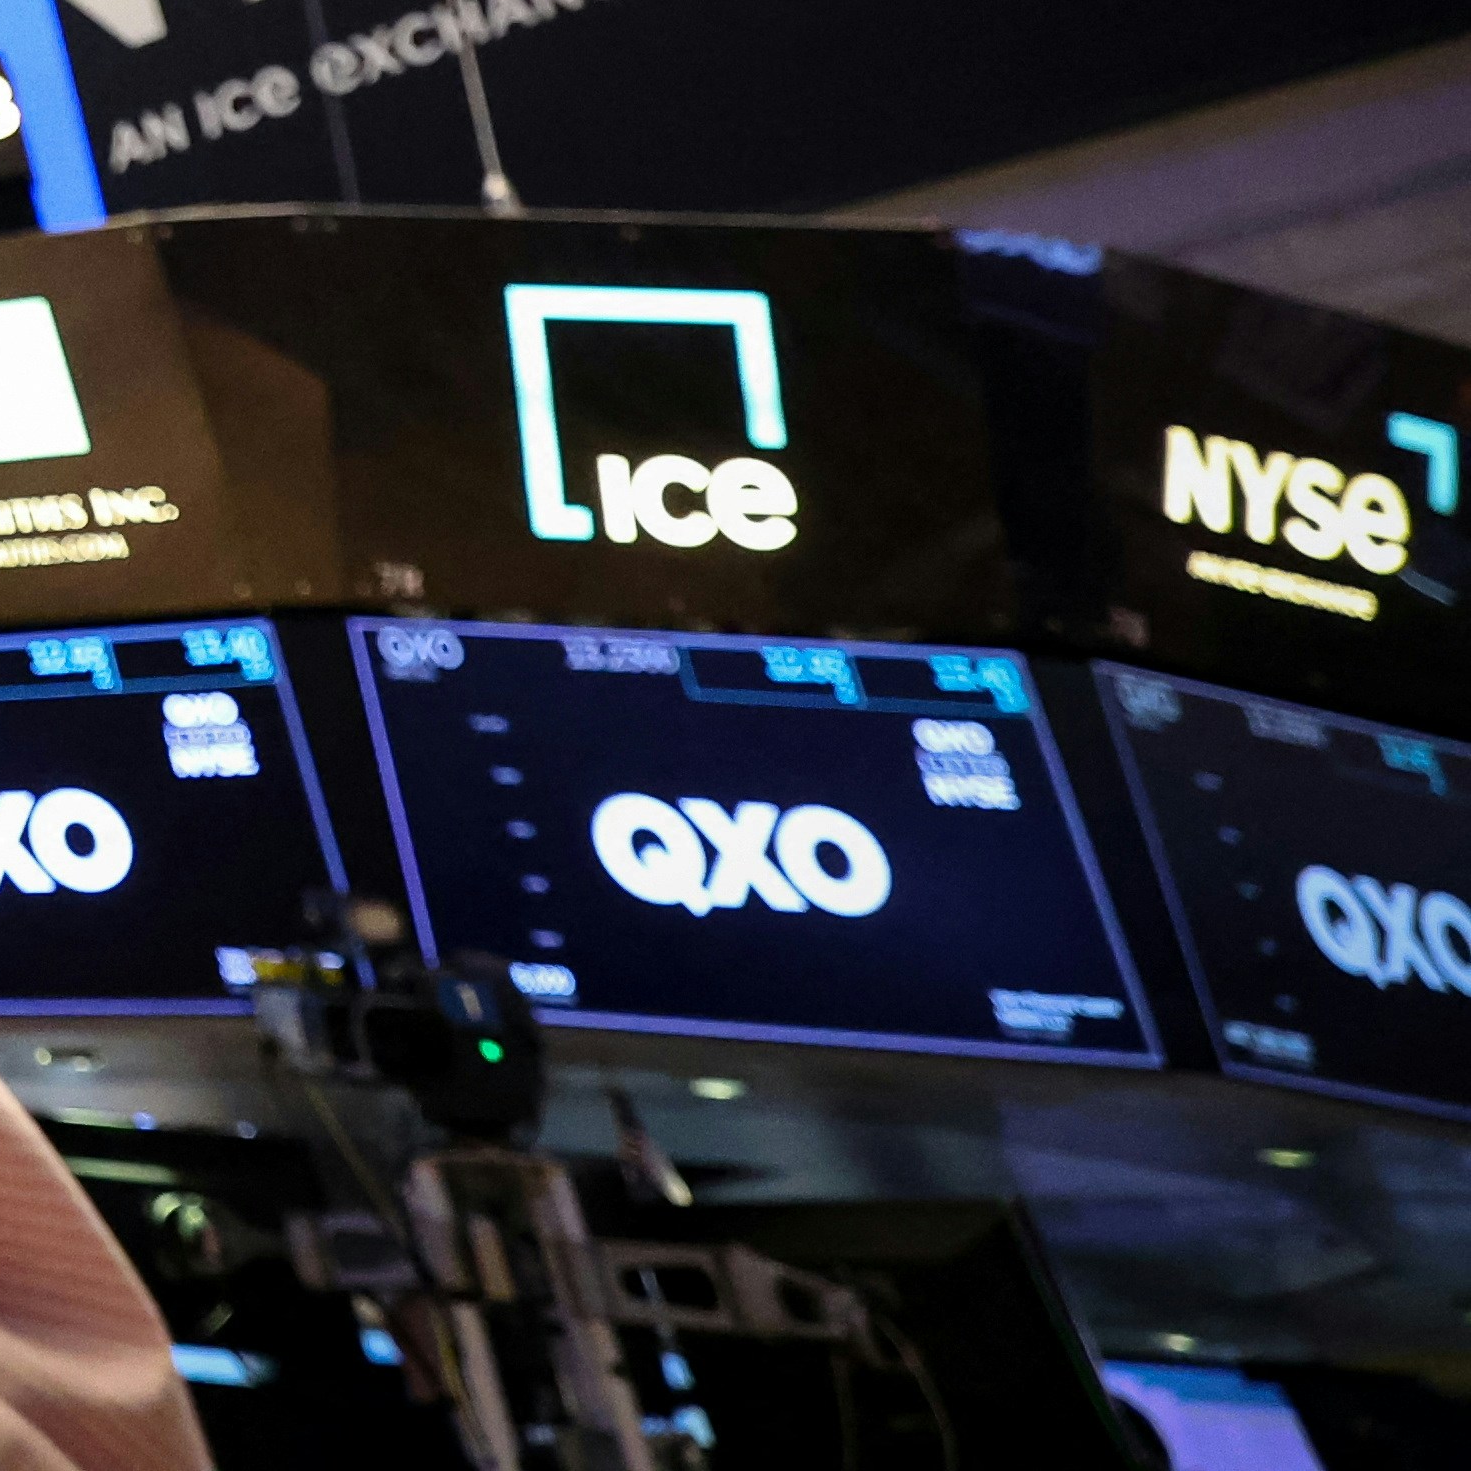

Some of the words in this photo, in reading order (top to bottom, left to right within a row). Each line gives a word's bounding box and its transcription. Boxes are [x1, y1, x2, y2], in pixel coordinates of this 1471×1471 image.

[109, 102, 191, 173] AN
[591, 792, 892, 918] QXO
[1294, 863, 1471, 999] QXO
